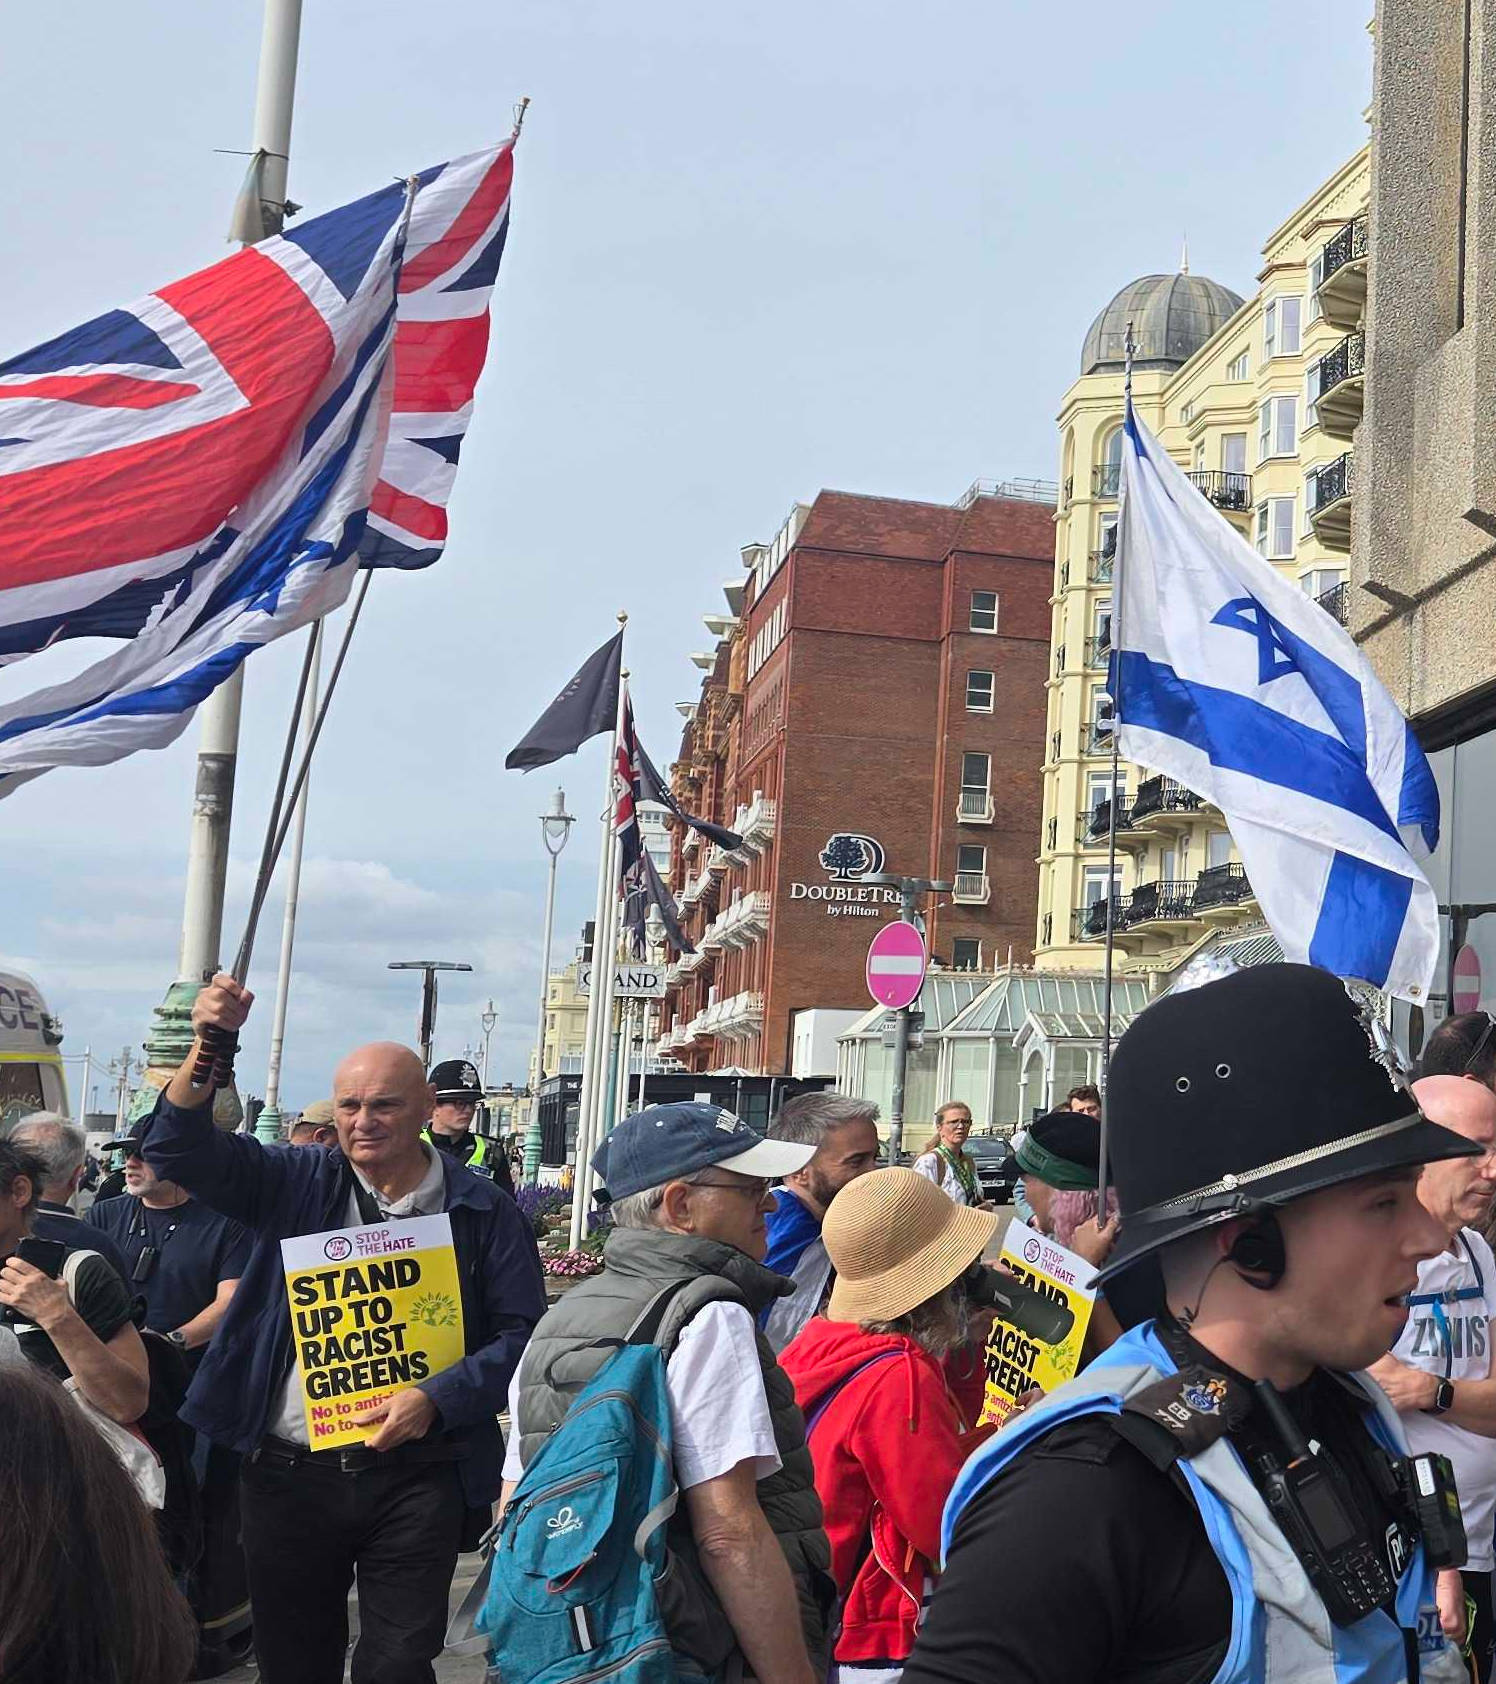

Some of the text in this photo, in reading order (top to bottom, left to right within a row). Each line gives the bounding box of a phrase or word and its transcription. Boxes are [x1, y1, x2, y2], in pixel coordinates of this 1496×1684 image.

[789, 882, 903, 905] DOUBLETRE
[826, 904, 879, 917] by Hilton
[582, 970, 658, 989] AND
[355, 1229, 390, 1245] STOP
[357, 1237, 416, 1257] THE HATE
[1043, 1247, 1064, 1265] STOP
[292, 1258, 421, 1306] STAND
[1040, 1258, 1076, 1286] THE HATE
[296, 1295, 393, 1339] UP TO
[300, 1323, 407, 1370] RACIST
[985, 1324, 1041, 1373] ACIST
[305, 1351, 430, 1400] GREENS
[982, 1353, 1041, 1398] REEN
[311, 1406, 333, 1421] No
[336, 1402, 351, 1415] to
[313, 1422, 335, 1437] No
[338, 1418, 354, 1432] to
